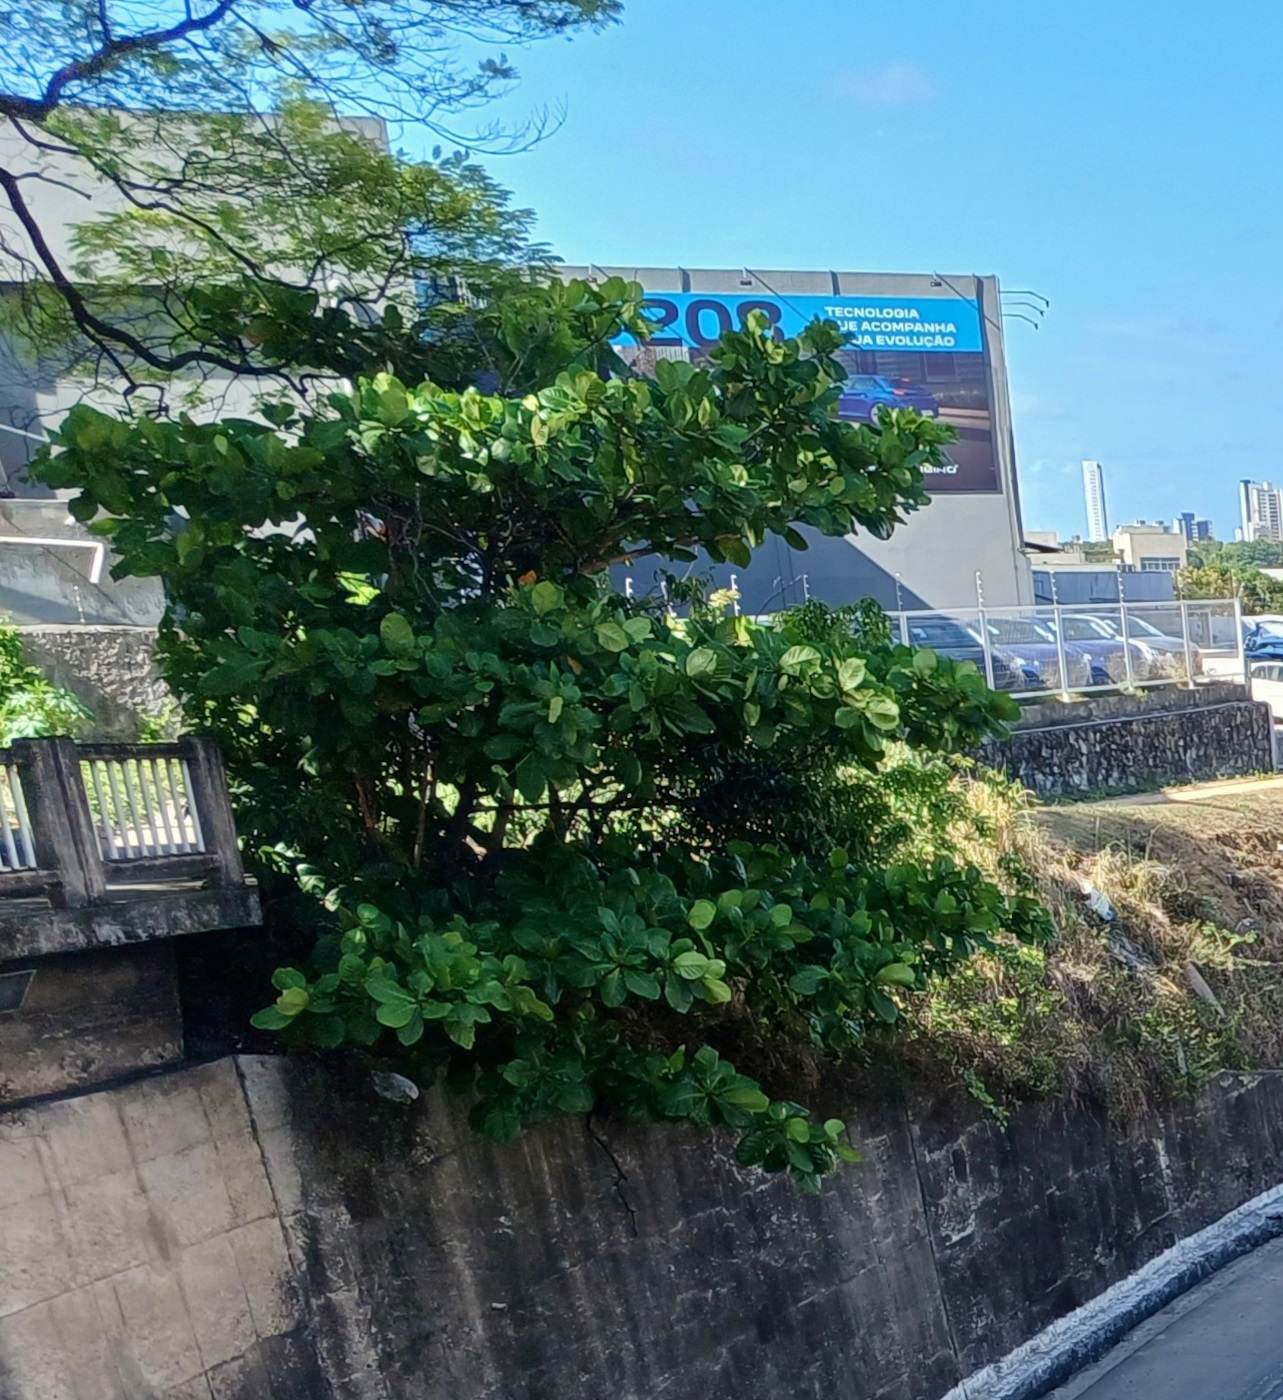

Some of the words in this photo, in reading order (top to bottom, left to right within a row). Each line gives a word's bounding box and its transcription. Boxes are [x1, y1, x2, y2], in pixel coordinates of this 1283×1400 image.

[824, 306, 920, 319] TECNOLOGIA
[838, 321, 858, 332] UE
[861, 321, 957, 333] ACOMPANHA
[875, 334, 955, 348] EVOLUÇÃO
